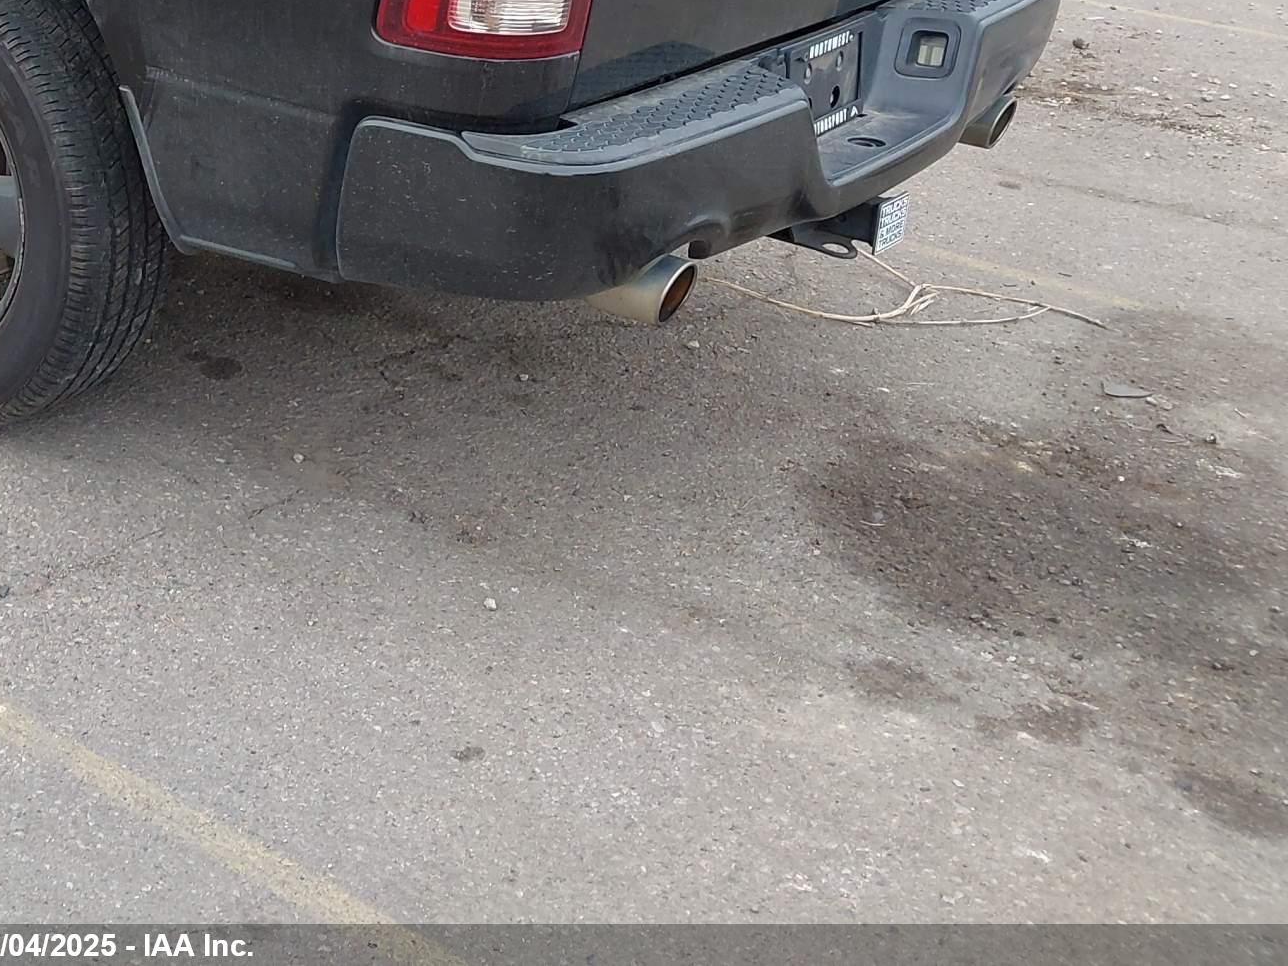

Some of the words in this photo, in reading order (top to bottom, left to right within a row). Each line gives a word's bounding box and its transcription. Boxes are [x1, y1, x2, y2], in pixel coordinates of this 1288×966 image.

[809, 30, 850, 59] NORTHWEST
[814, 108, 847, 137] TORSPORT
[882, 197, 909, 216] TRUCKS
[881, 207, 907, 228] TRUCKS
[886, 220, 905, 236] MORE
[878, 230, 903, 248] TRUCKS
